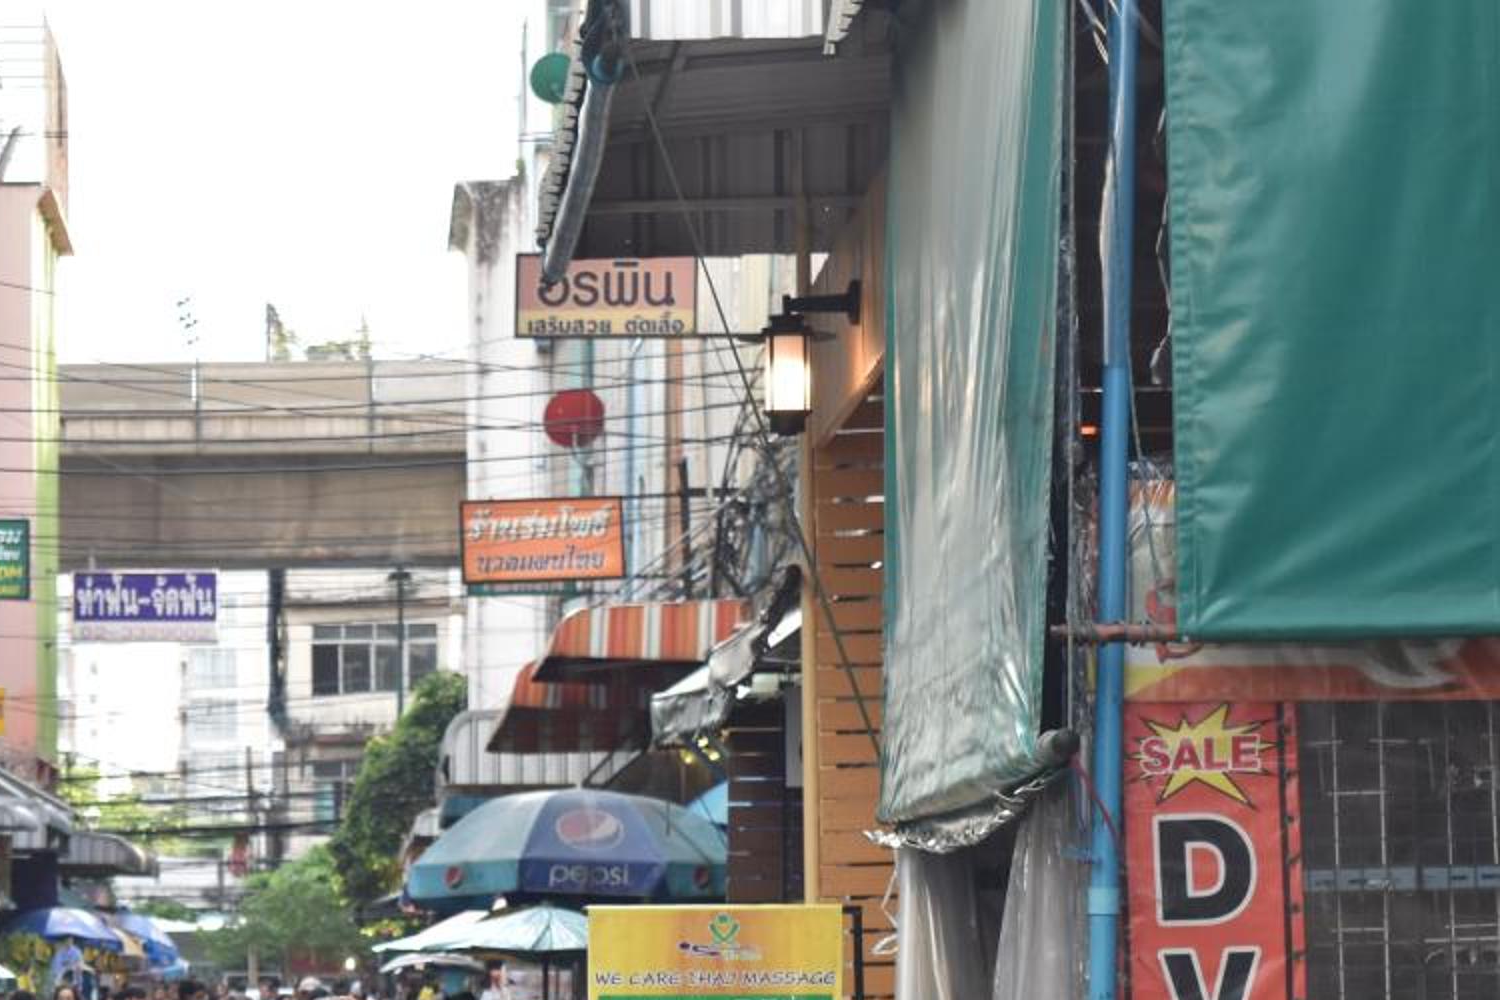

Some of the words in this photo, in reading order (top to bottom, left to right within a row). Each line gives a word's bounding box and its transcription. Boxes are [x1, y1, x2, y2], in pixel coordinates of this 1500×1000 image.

[1139, 734, 1261, 774] SALE
[595, 971, 622, 986] WE
[629, 971, 678, 986] CARE
[743, 970, 837, 987] MASSAGE
